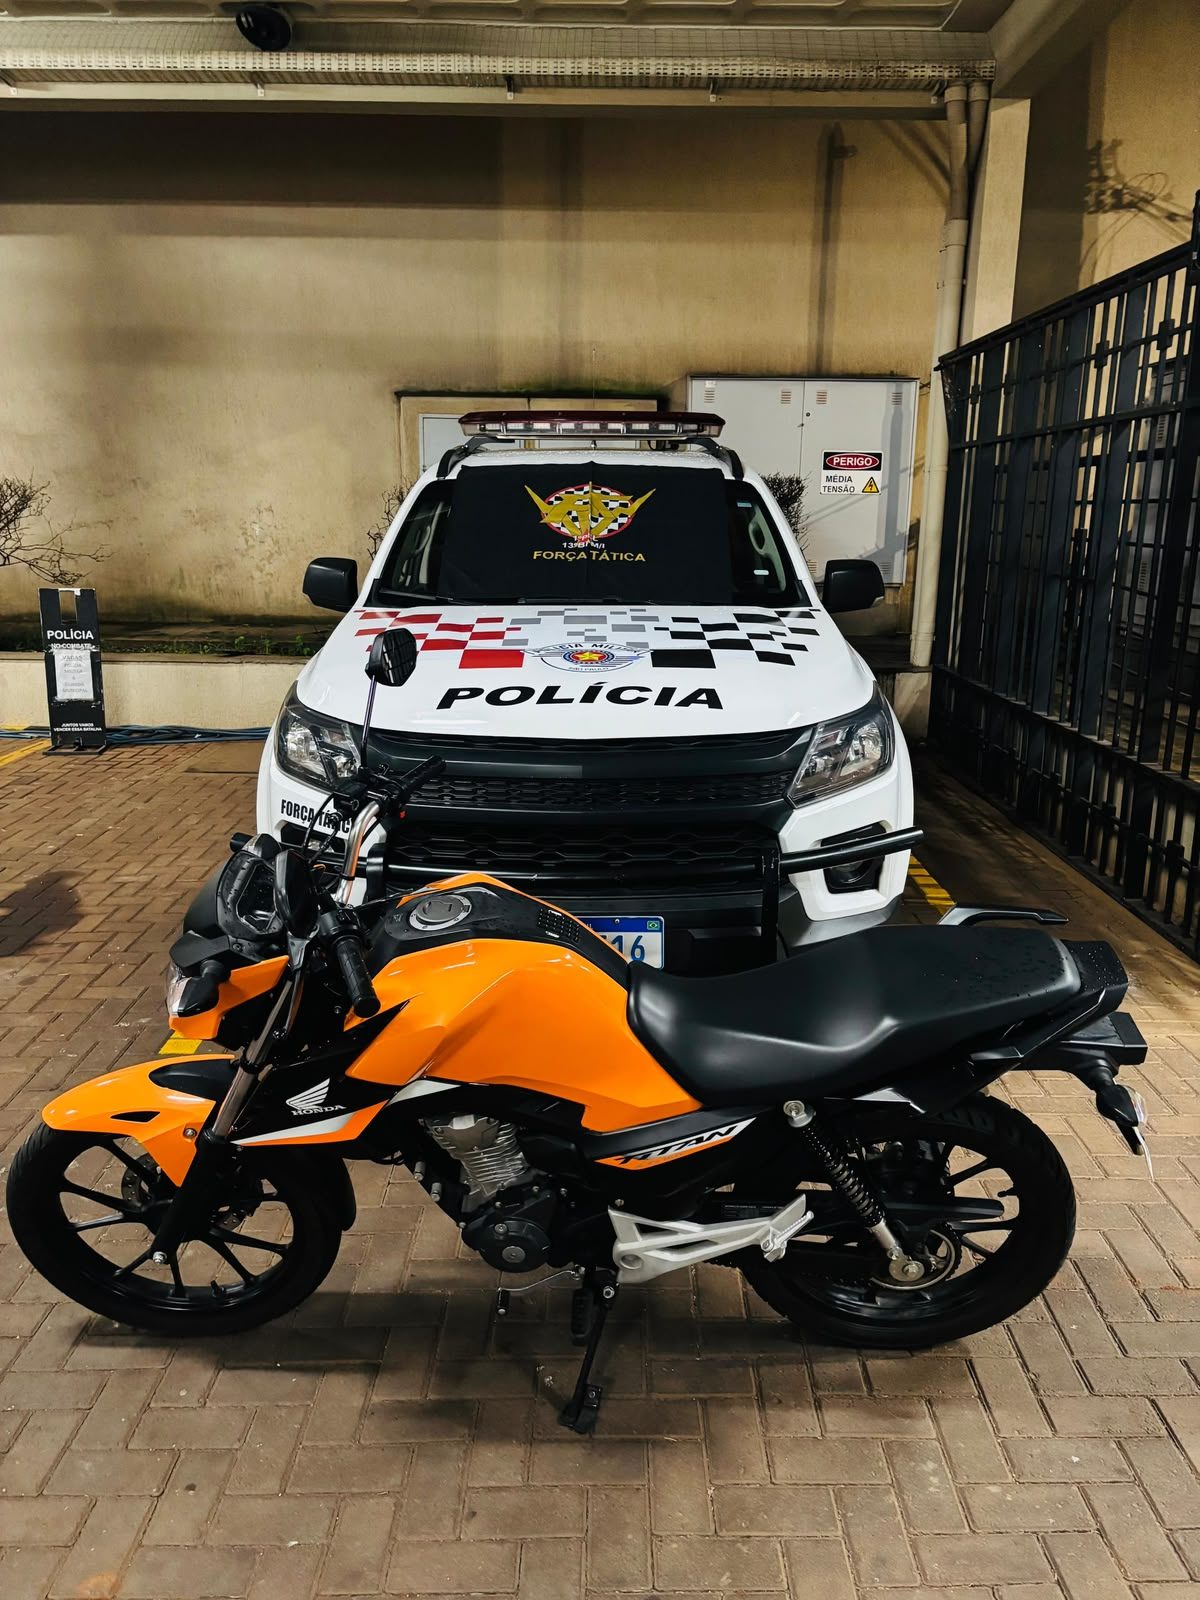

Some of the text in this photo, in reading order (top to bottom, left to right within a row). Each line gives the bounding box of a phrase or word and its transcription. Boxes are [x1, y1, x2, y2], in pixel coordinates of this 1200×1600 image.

[833, 457, 873, 466] PERIGO
[825, 474, 853, 483] MÉDIA
[822, 484, 856, 493] TENSÃO
[533, 550, 646, 561] FORÇA TÁTICA
[46, 628, 95, 640] POLÍCIA
[436, 682, 723, 710] POLÍCIA
[281, 799, 315, 824] FORÇA
[291, 1104, 347, 1116] HONDA
[613, 1125, 738, 1165] TITAN
